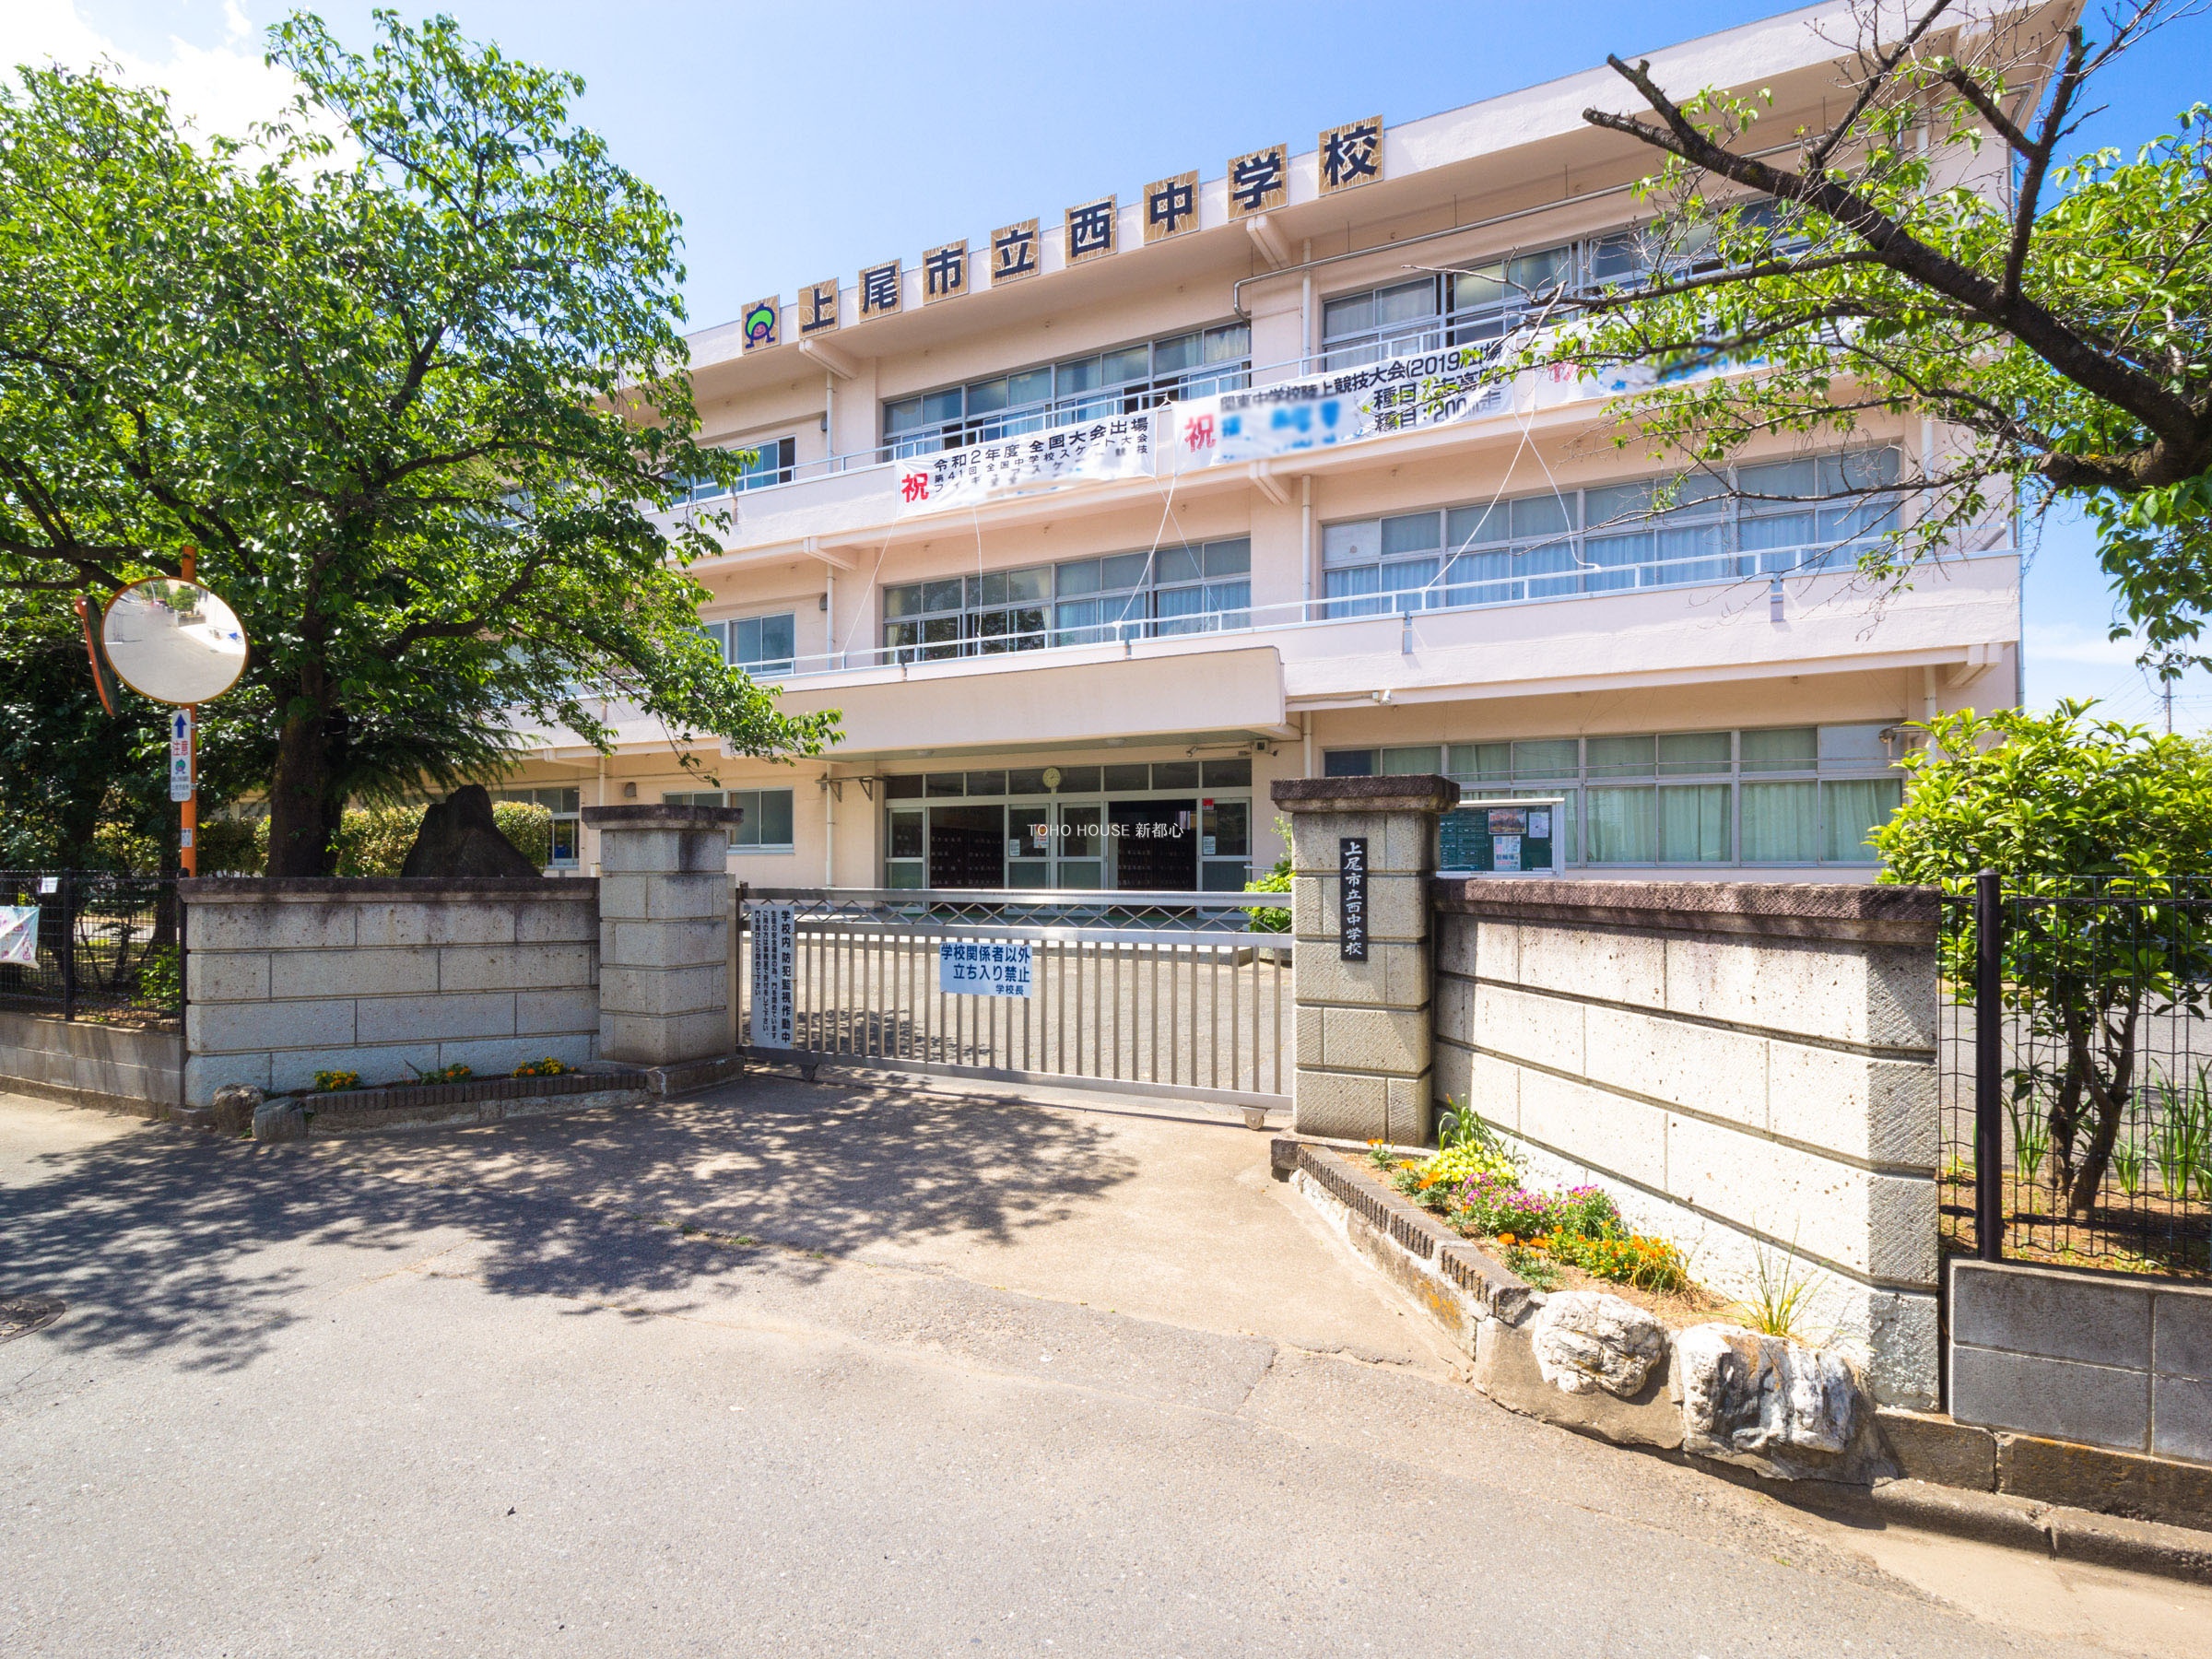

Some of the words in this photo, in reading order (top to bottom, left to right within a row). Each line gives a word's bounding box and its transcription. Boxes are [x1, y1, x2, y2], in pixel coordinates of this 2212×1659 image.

[800, 124, 1379, 334] 上尾市立西中学校
[1029, 417, 1149, 453] 全国大会出場
[1184, 413, 1217, 453] 祝
[900, 472, 930, 503] 祝
[1344, 841, 1363, 956] 上尾市立西中学校
[941, 944, 1030, 964] 学校関係者以外
[953, 963, 1030, 982] 立ち入り禁止
[995, 984, 1024, 995] 学校長
